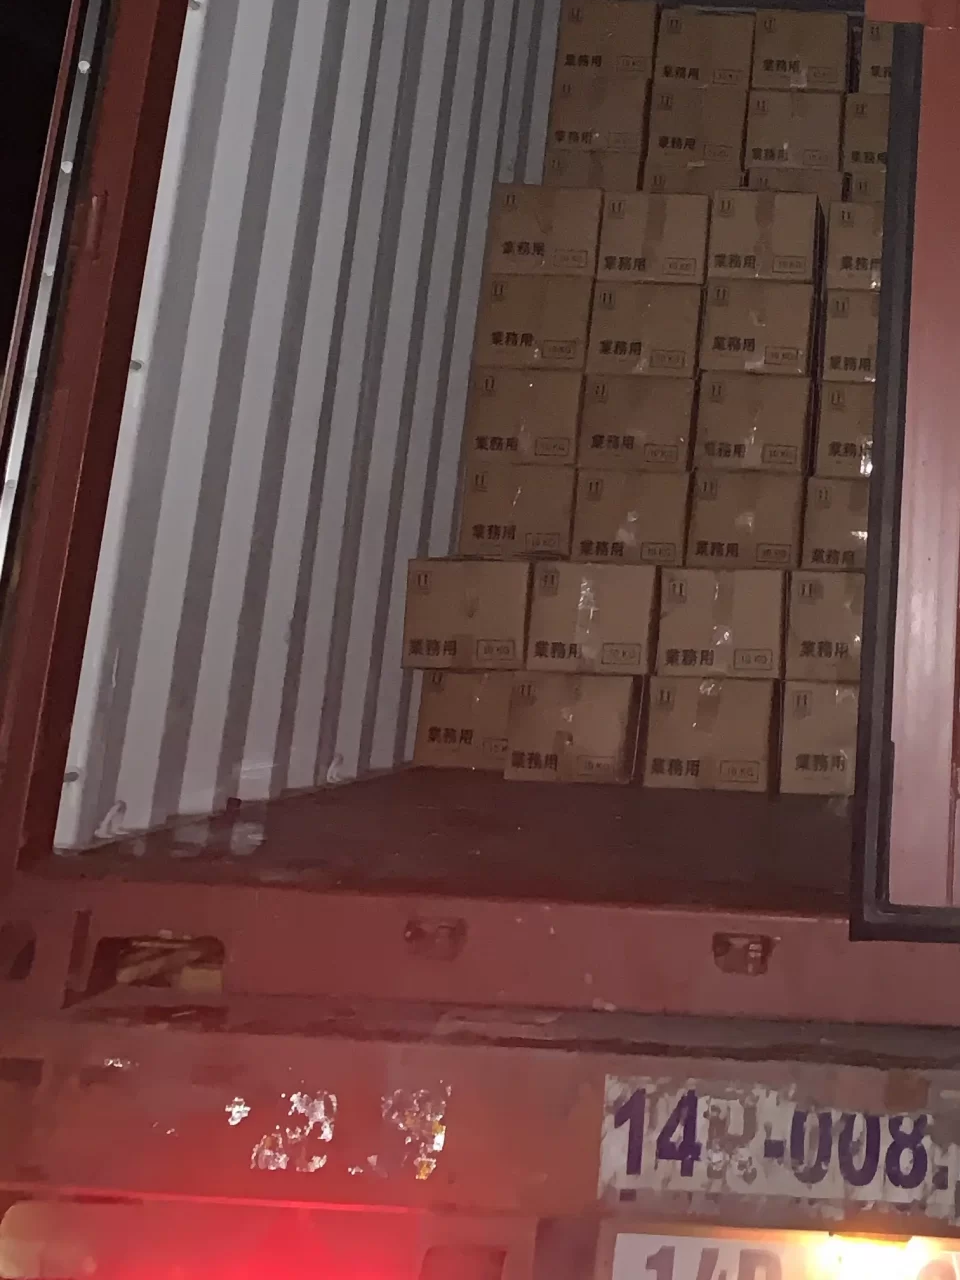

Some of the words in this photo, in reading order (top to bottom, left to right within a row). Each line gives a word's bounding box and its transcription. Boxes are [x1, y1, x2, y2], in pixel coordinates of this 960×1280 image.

[871, 65, 891, 78] 業務
[604, 255, 646, 271] 業務用
[714, 253, 756, 269] 業務用
[600, 339, 642, 355] 業務用
[712, 336, 755, 352] 業務用
[830, 355, 871, 371] 業務用
[580, 540, 625, 557] 業務用
[695, 540, 739, 558] 業務用
[408, 638, 457, 656] 業務用
[799, 640, 849, 658] 業務用
[664, 648, 715, 666] 業務用
[427, 726, 474, 745] 業務用
[511, 750, 559, 770] 業務用
[651, 757, 700, 776] 業務用
